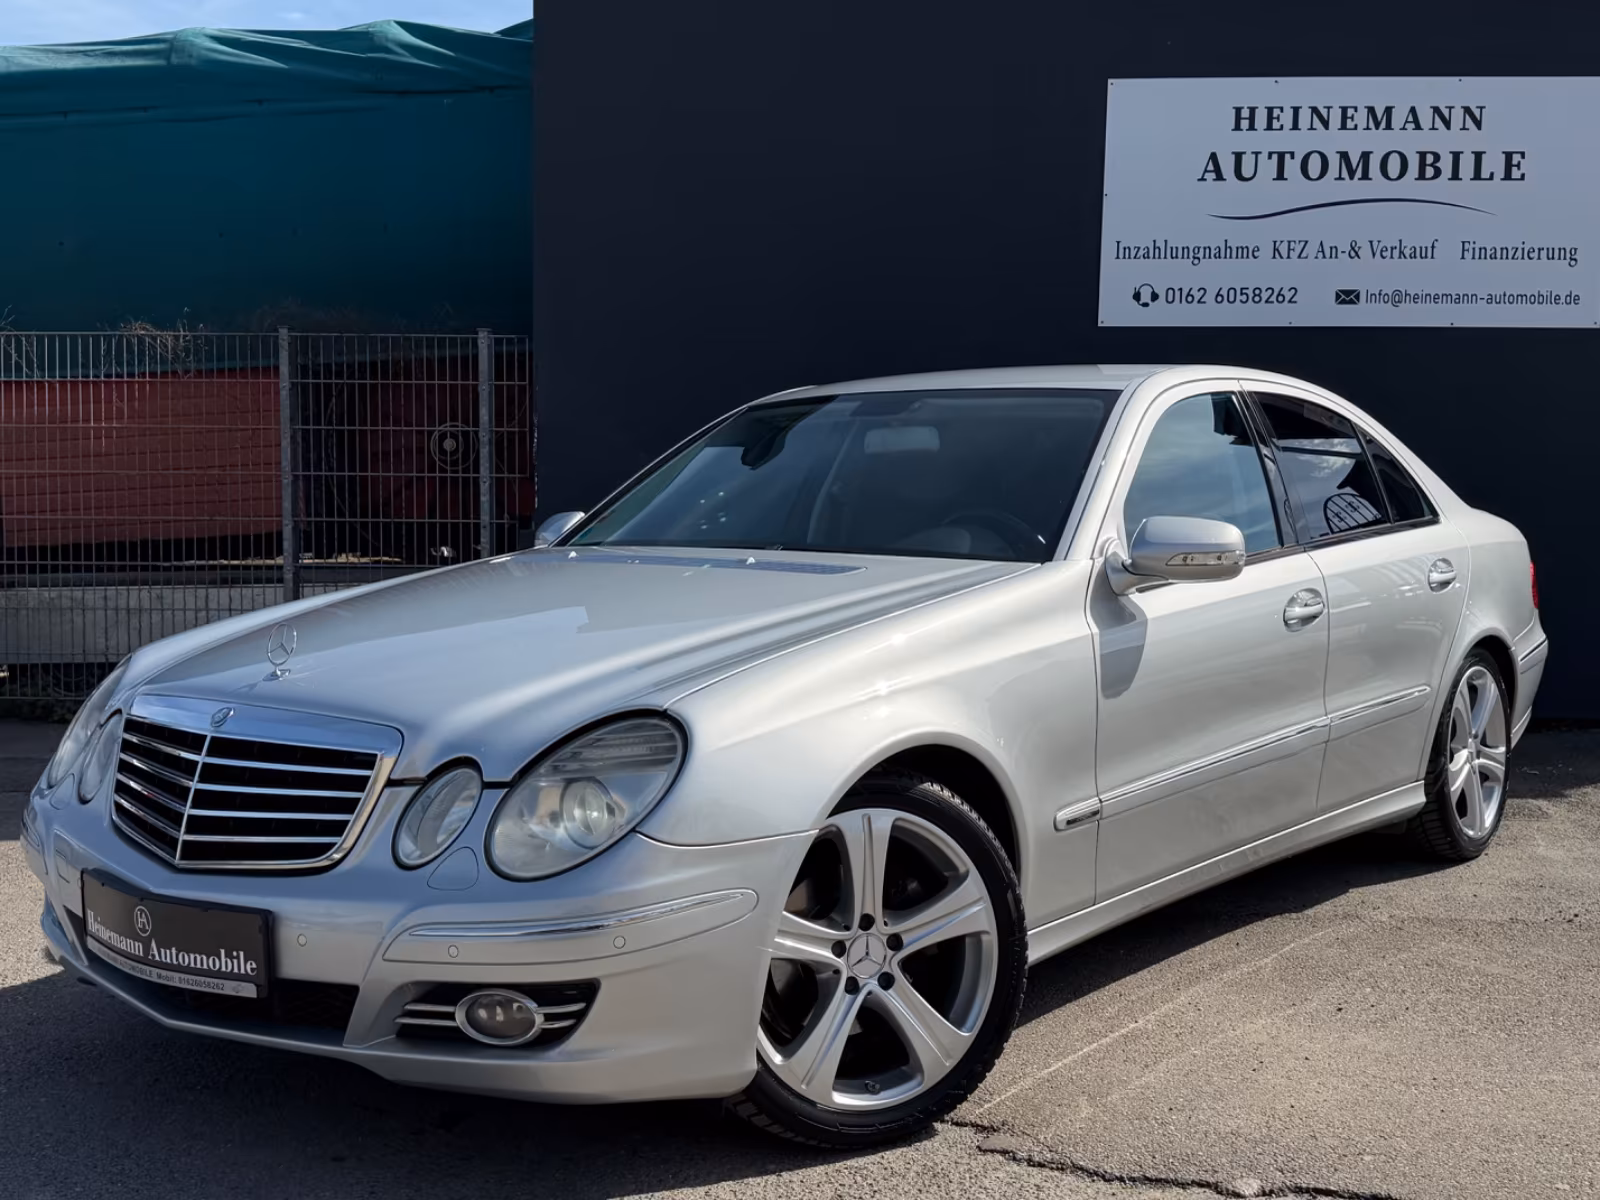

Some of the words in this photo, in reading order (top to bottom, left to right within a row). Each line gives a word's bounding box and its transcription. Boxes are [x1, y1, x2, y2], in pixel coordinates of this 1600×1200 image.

[1231, 105, 1487, 132] HEINEMANN
[1196, 149, 1526, 183] AUTOMOBILE
[1114, 238, 1261, 267] Inzahlungnahme
[1271, 239, 1309, 260] KFZ
[1368, 238, 1439, 260] Verkauf
[1459, 240, 1579, 268] Finanzierung
[1164, 286, 1208, 305] 0162
[1213, 286, 1299, 305] 6058262
[1365, 288, 1581, 308] Info@heinemann-automobile.de
[87, 908, 144, 957] Heinemann
[148, 938, 258, 976] Automobile
